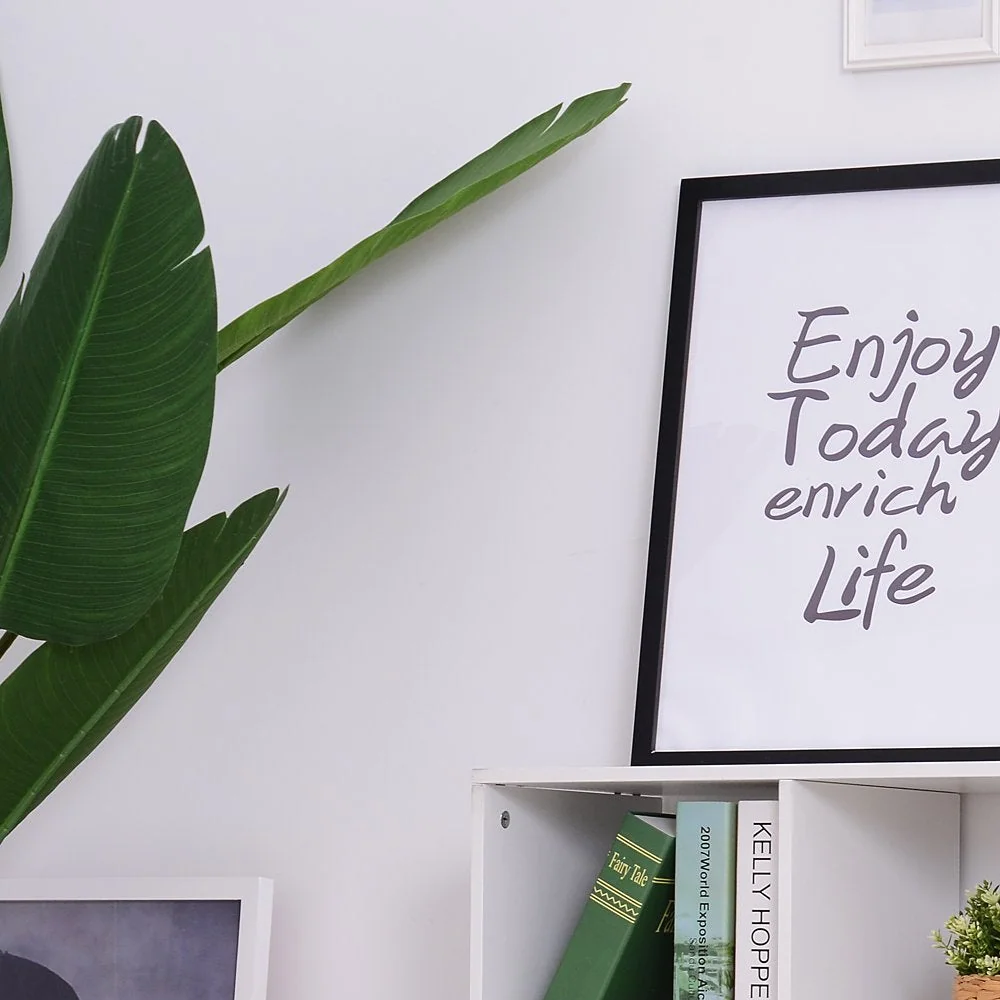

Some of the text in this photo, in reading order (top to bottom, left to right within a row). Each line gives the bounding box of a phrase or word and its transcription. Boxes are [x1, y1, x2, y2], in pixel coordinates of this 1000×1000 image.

[788, 306, 1000, 402] Enjoy
[764, 455, 957, 520] enrich
[803, 528, 935, 630] Life
[608, 851, 649, 887] Fairy Tale
[751, 822, 772, 900] KELLY
[697, 902, 710, 974] Exposition
